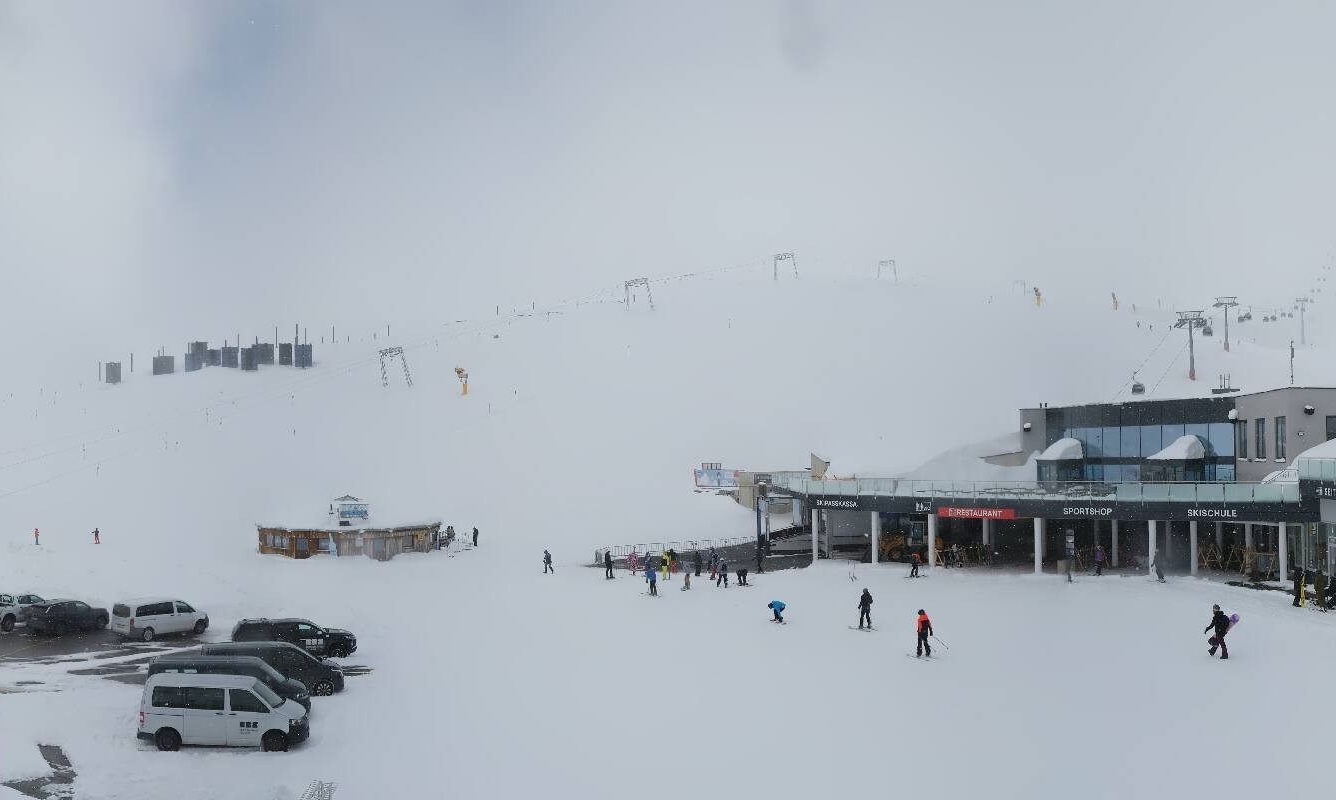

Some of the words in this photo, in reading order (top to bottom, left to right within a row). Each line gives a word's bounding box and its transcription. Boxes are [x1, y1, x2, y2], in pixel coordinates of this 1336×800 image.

[956, 509, 1003, 517] RESTAURANT
[1063, 507, 1113, 516] SPORTSHOP
[1187, 508, 1238, 517] SKISCHULE
